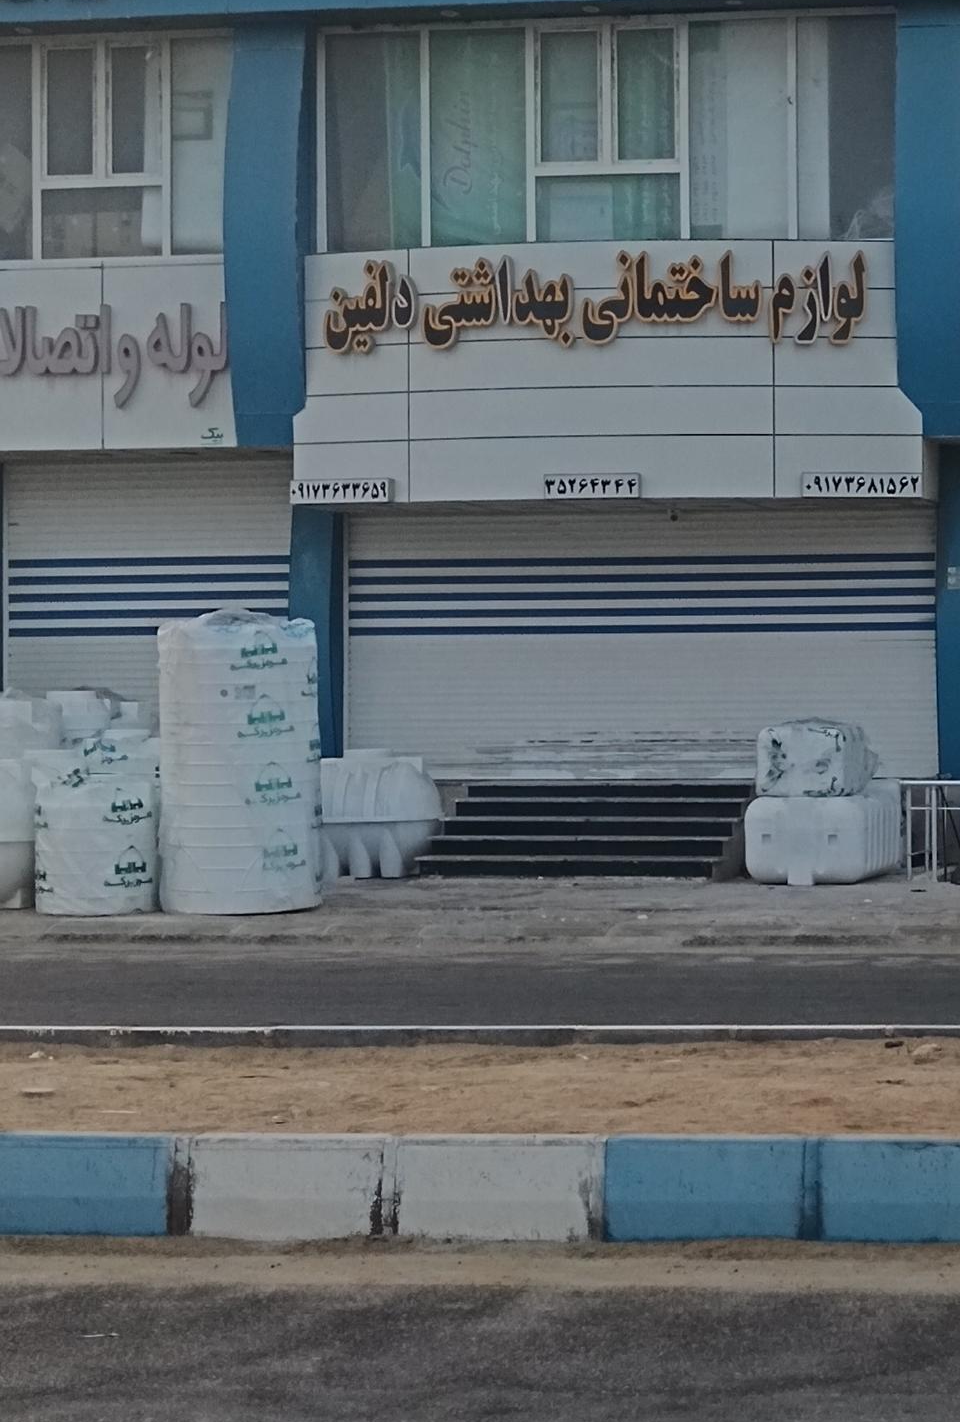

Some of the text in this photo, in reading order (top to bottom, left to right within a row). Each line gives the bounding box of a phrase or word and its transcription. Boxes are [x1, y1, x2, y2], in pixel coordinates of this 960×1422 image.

[324, 248, 868, 355] لوازم ساختمانی بهداشتی دلفین
[0, 303, 112, 377] اتصالا
[147, 301, 228, 408] لوله
[544, 478, 637, 495] ۳۵۲۶۴۳۴۴
[805, 475, 920, 494] ۰۹۱۷۳۶۸۱۵۶۲
